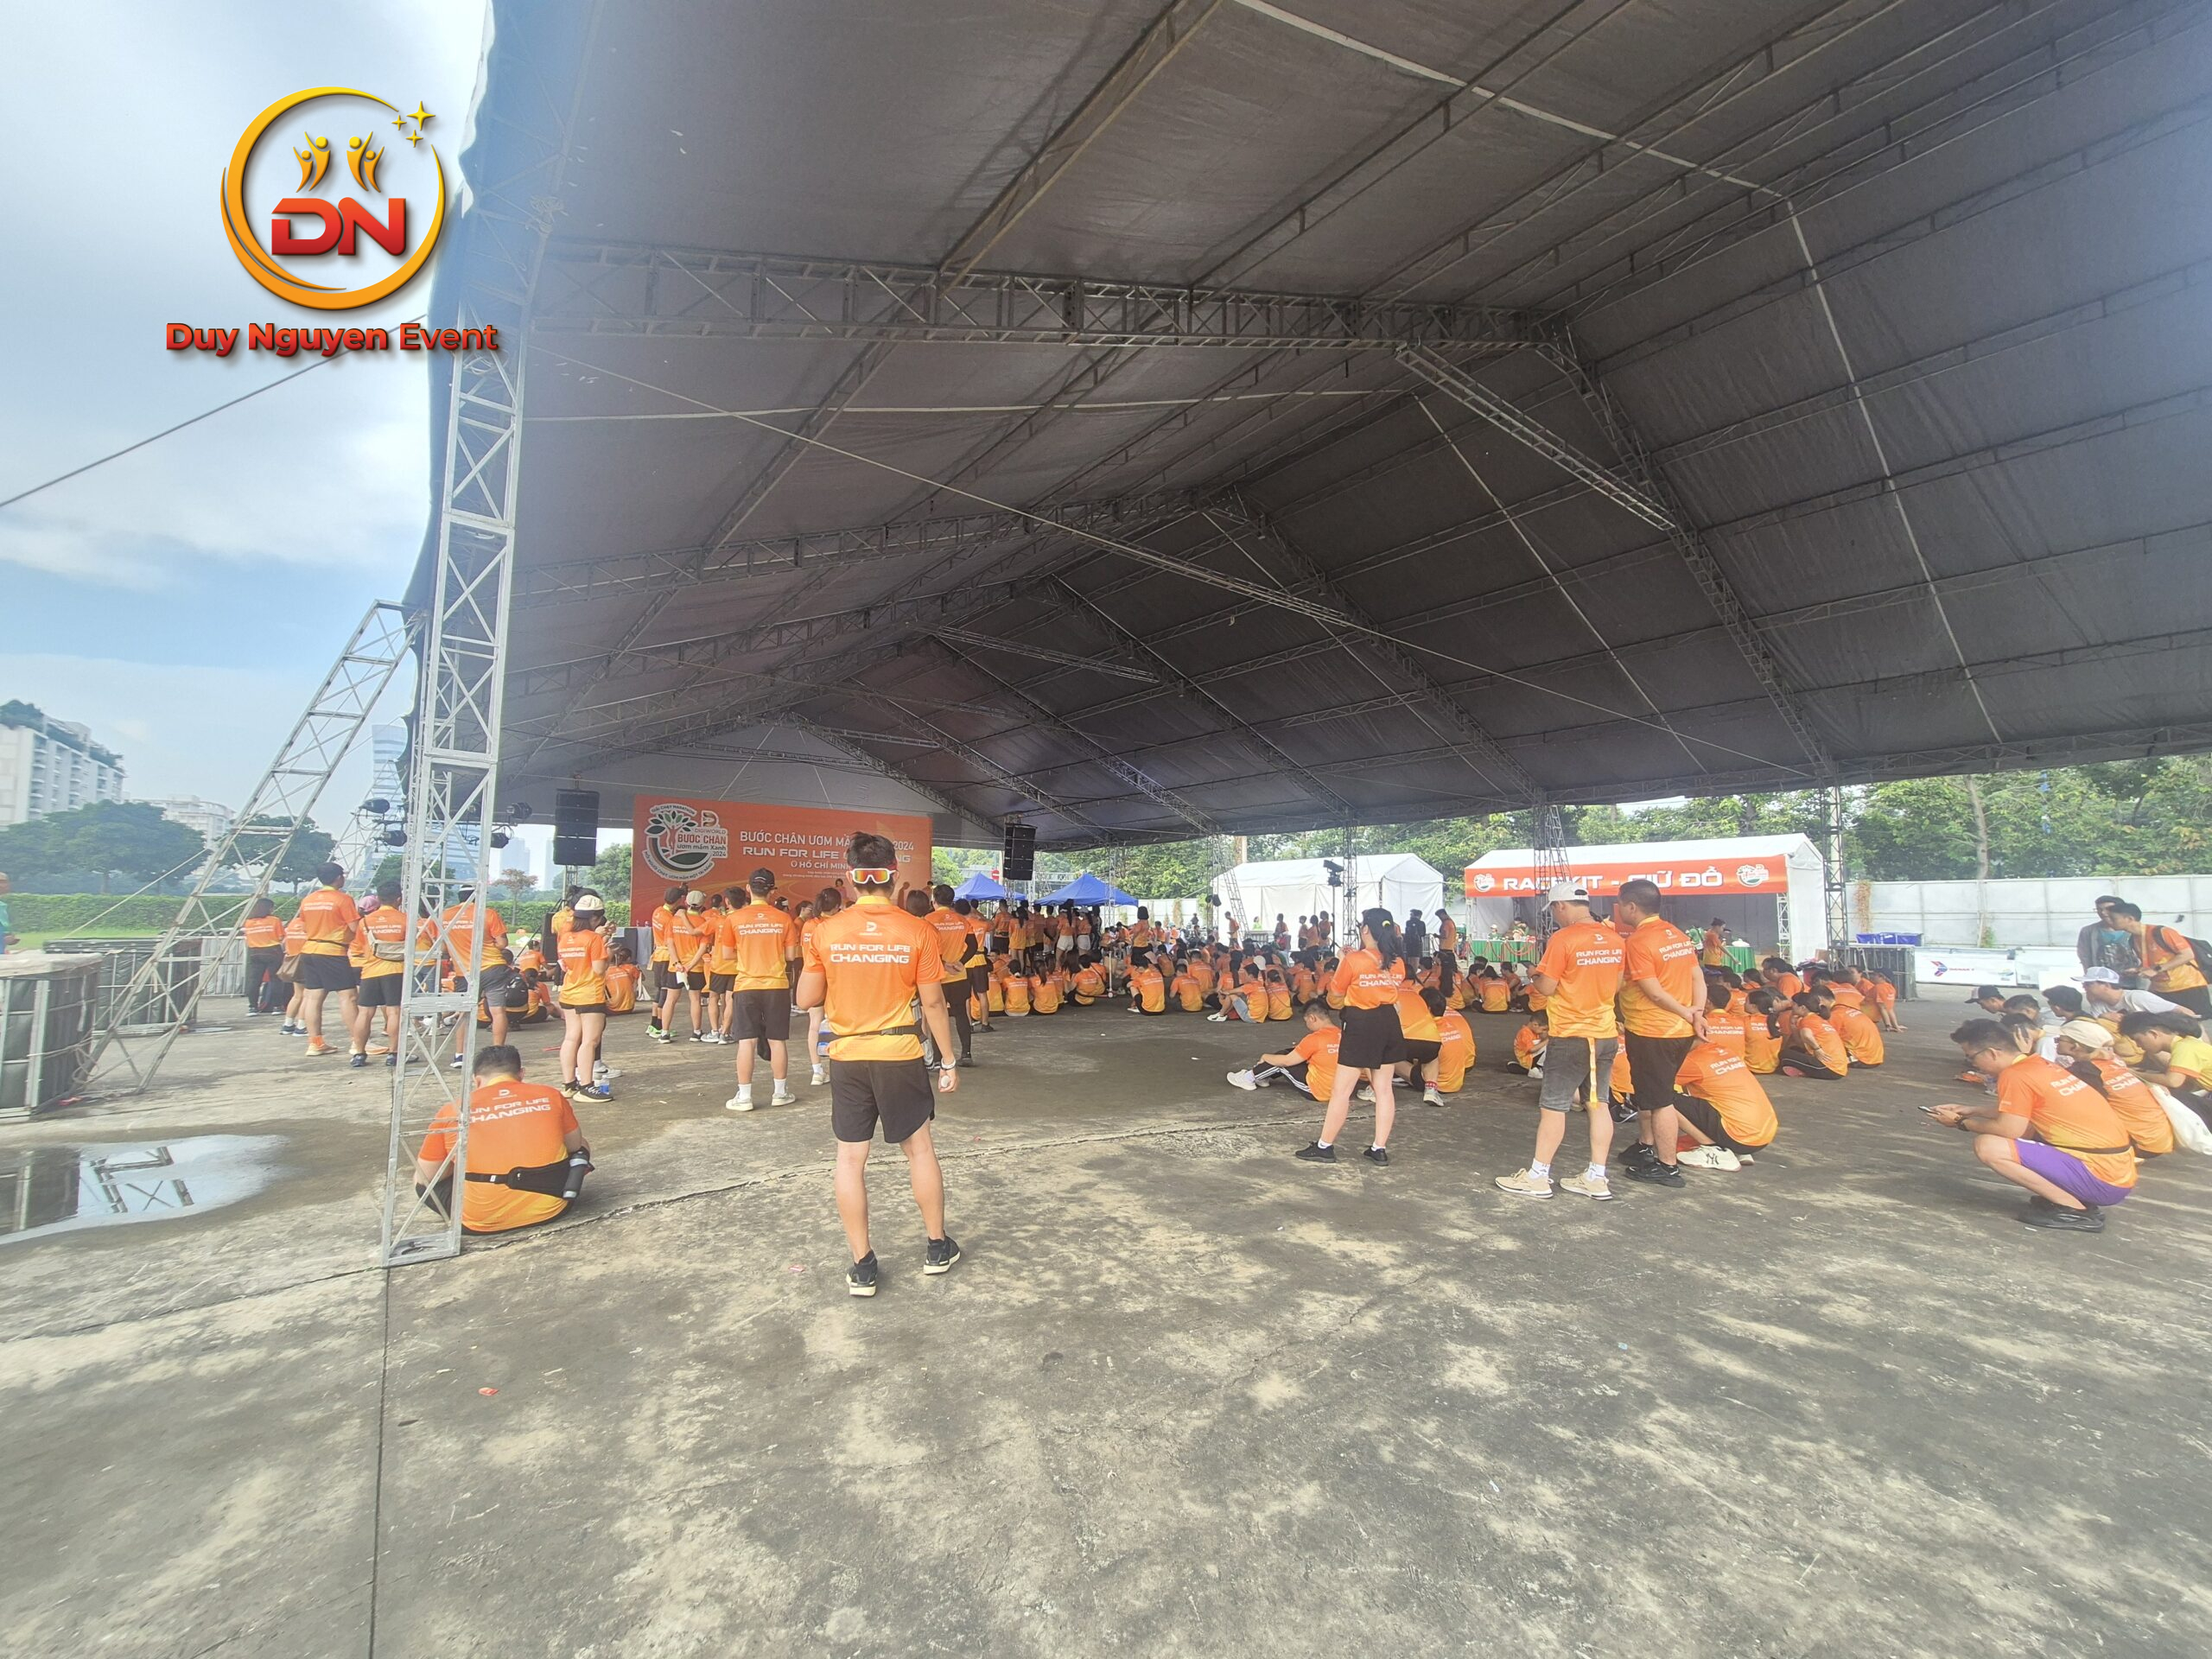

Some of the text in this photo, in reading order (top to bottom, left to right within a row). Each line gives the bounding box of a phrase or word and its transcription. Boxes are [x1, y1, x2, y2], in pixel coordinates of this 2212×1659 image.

[740, 830, 914, 850] BƯỚC CHÂN ƯƠM MẦ 2024
[743, 847, 775, 855] RUN
[779, 849, 808, 857] FOR
[812, 850, 839, 859] LIFE
[1679, 866, 1723, 887] ĐỒ
[830, 954, 910, 963] CHANGING
[1662, 948, 1694, 961] CHANGIN
[493, 1102, 522, 1110] FOR
[471, 1104, 551, 1123] HANGING
